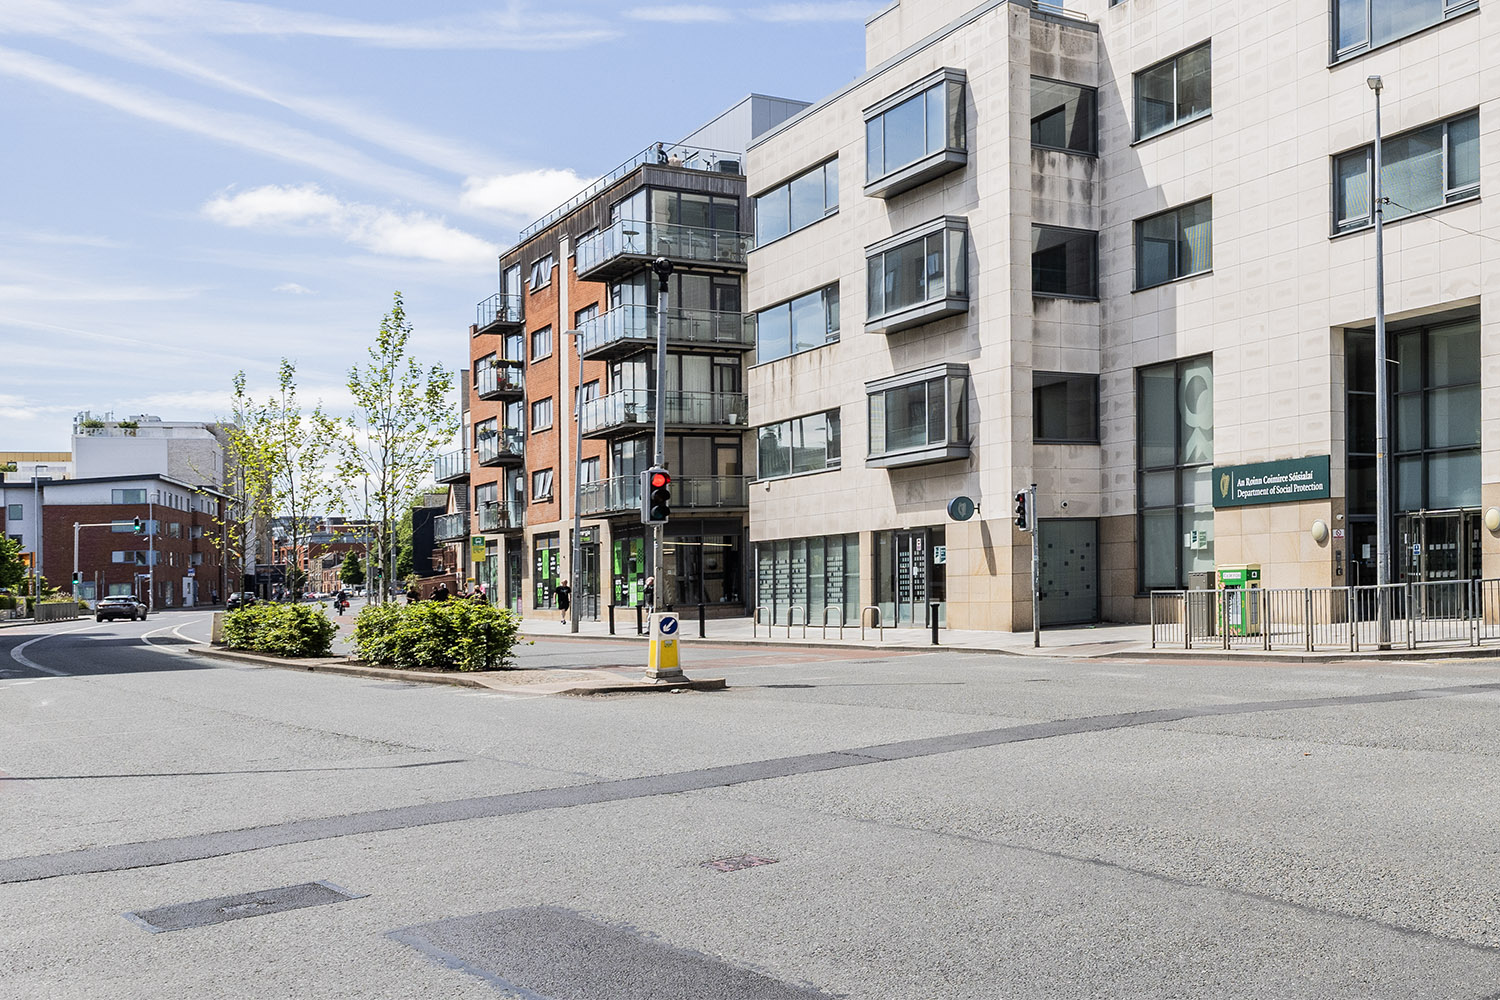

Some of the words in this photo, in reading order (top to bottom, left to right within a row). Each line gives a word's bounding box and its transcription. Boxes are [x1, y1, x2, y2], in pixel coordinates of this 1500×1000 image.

[1237, 478, 1245, 487] An
[1246, 476, 1262, 486] Roinn
[1263, 473, 1289, 484] Coimirce
[1237, 488, 1269, 499] Department
[1269, 485, 1276, 494] of
[1276, 483, 1293, 494] Social
[1294, 482, 1323, 493] Protection
